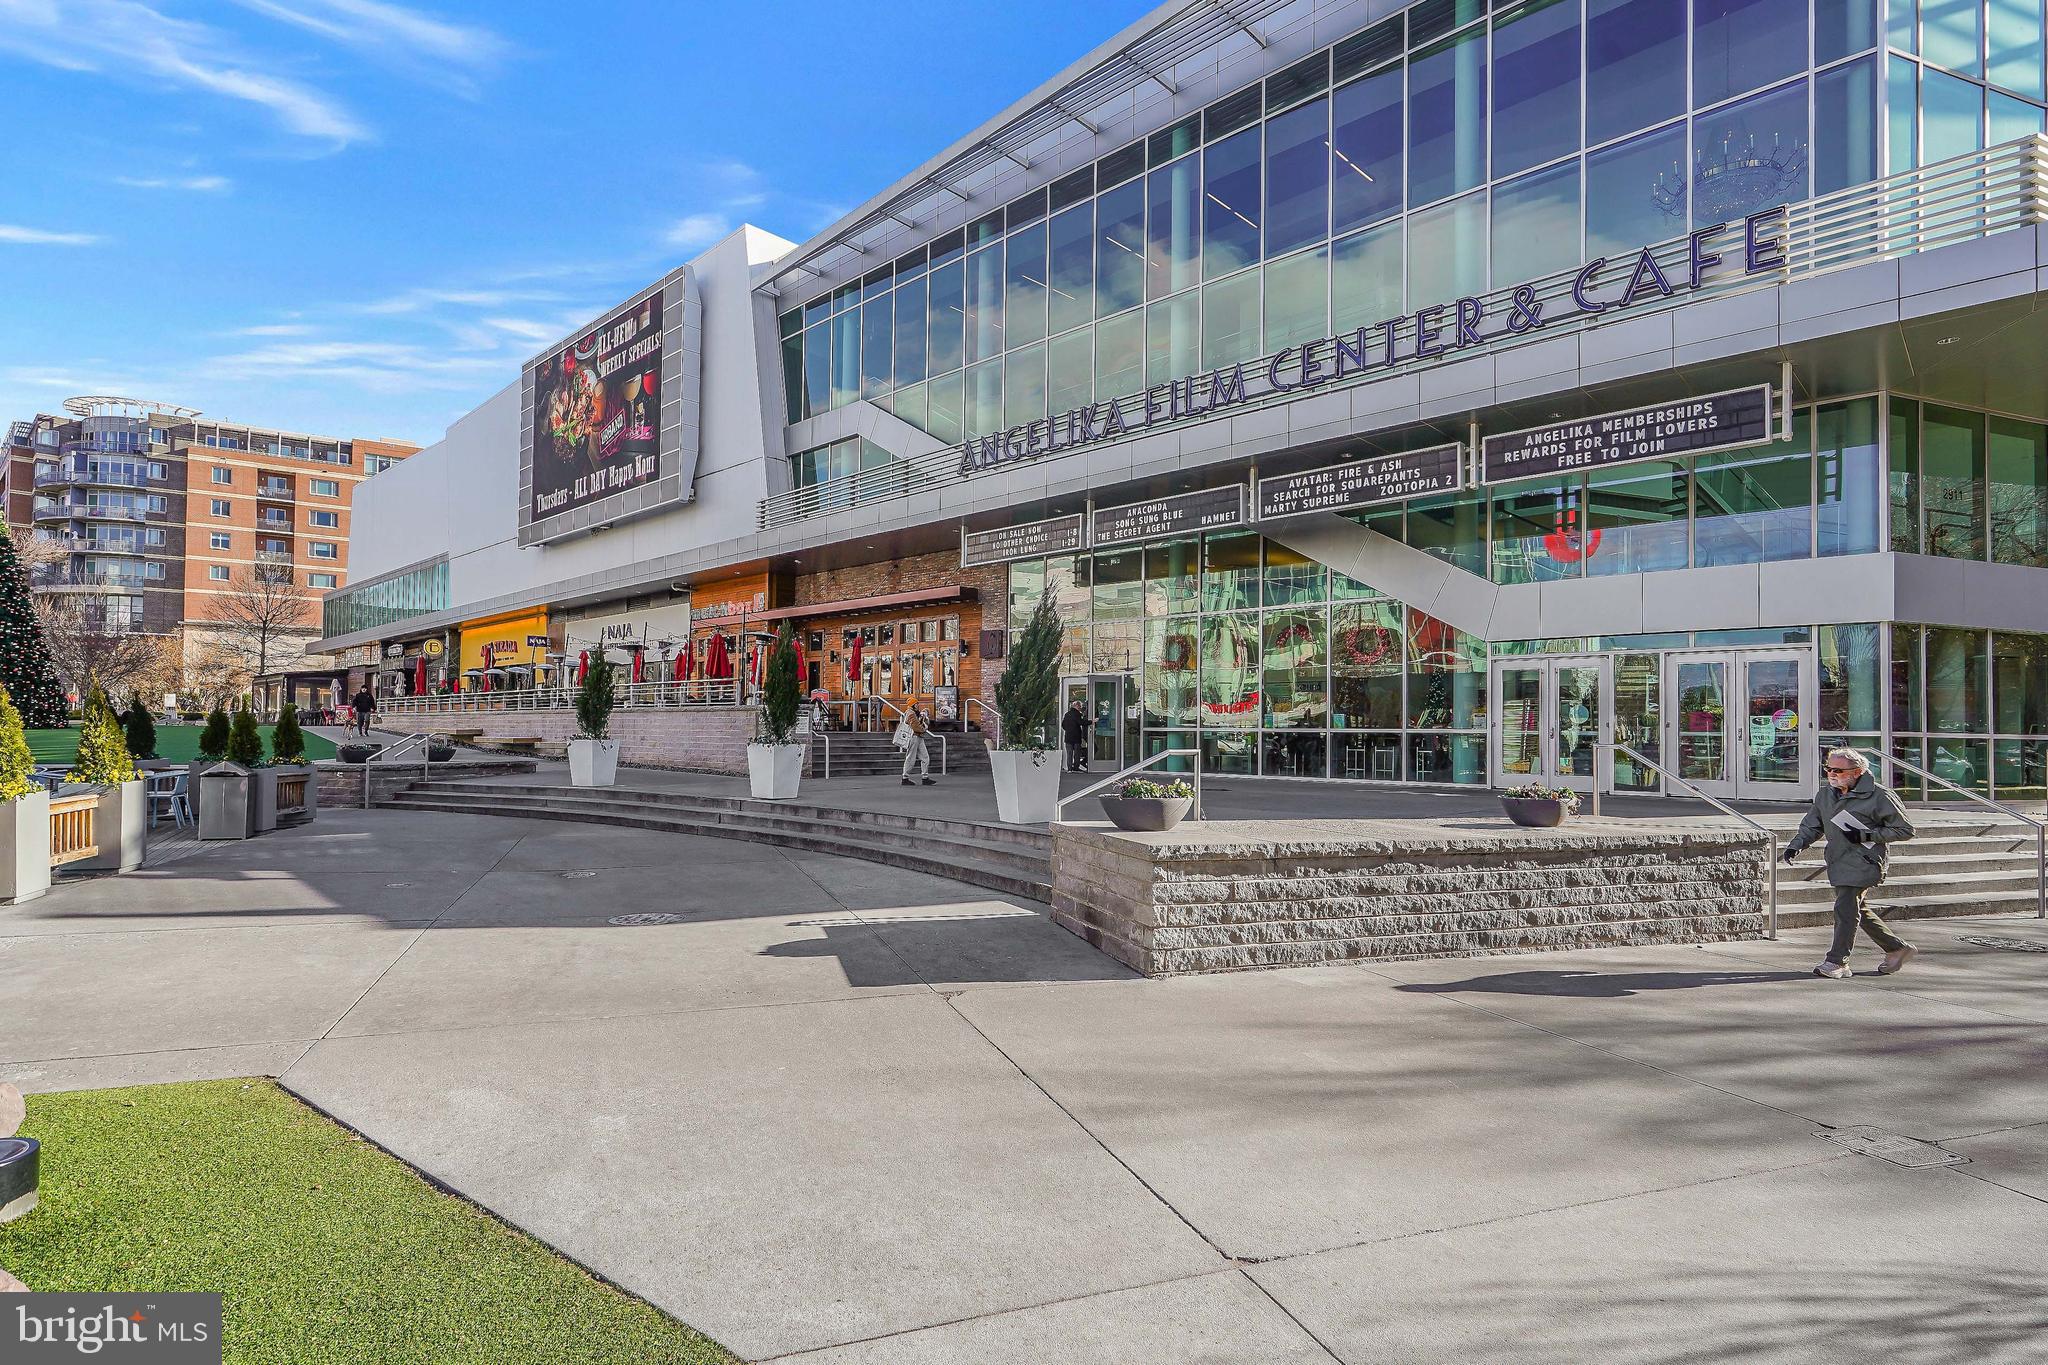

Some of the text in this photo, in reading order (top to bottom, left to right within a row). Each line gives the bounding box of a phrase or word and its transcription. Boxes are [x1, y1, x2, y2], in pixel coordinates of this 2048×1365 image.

[957, 203, 1789, 475] ANGELIKA FILM CENTER & CAFE
[600, 330, 662, 378] WEEKLY SPECIALS!
[1525, 401, 1713, 447] ANGELIKA MEMBERSHIPS
[1504, 416, 1718, 464] REWARDS FOR FILM LOVERS
[1557, 439, 1665, 468] FREE TO JOIN
[537, 489, 568, 513] Thursdays
[574, 476, 588, 500] ALL
[590, 469, 607, 494] DAY
[608, 465, 634, 487] Happy
[635, 455, 656, 478] Hour
[1273, 468, 1421, 503] SEARCH FOR SQUAREPANTS
[1288, 459, 1402, 489] AVATAR: FIRE & ASH
[1264, 475, 1452, 515] MARTY SUPREME ZOOTOPIA 2
[1943, 488, 1963, 501] 2911
[1115, 509, 1183, 529] SONG SUNG BLUE
[1127, 503, 1168, 517] ANACONDA
[998, 531, 1007, 540] ON
[1010, 528, 1025, 538] SALE
[1003, 537, 1023, 547] OTHER
[1026, 533, 1048, 543] CHOICE
[1067, 528, 1077, 537] 1-8
[1098, 511, 1236, 541] THE SECRET AGENT HAMNET
[1002, 537, 1075, 556] IRON LUNG 1-29
[608, 622, 633, 640] NAJA
[428, 642, 440, 653] B
